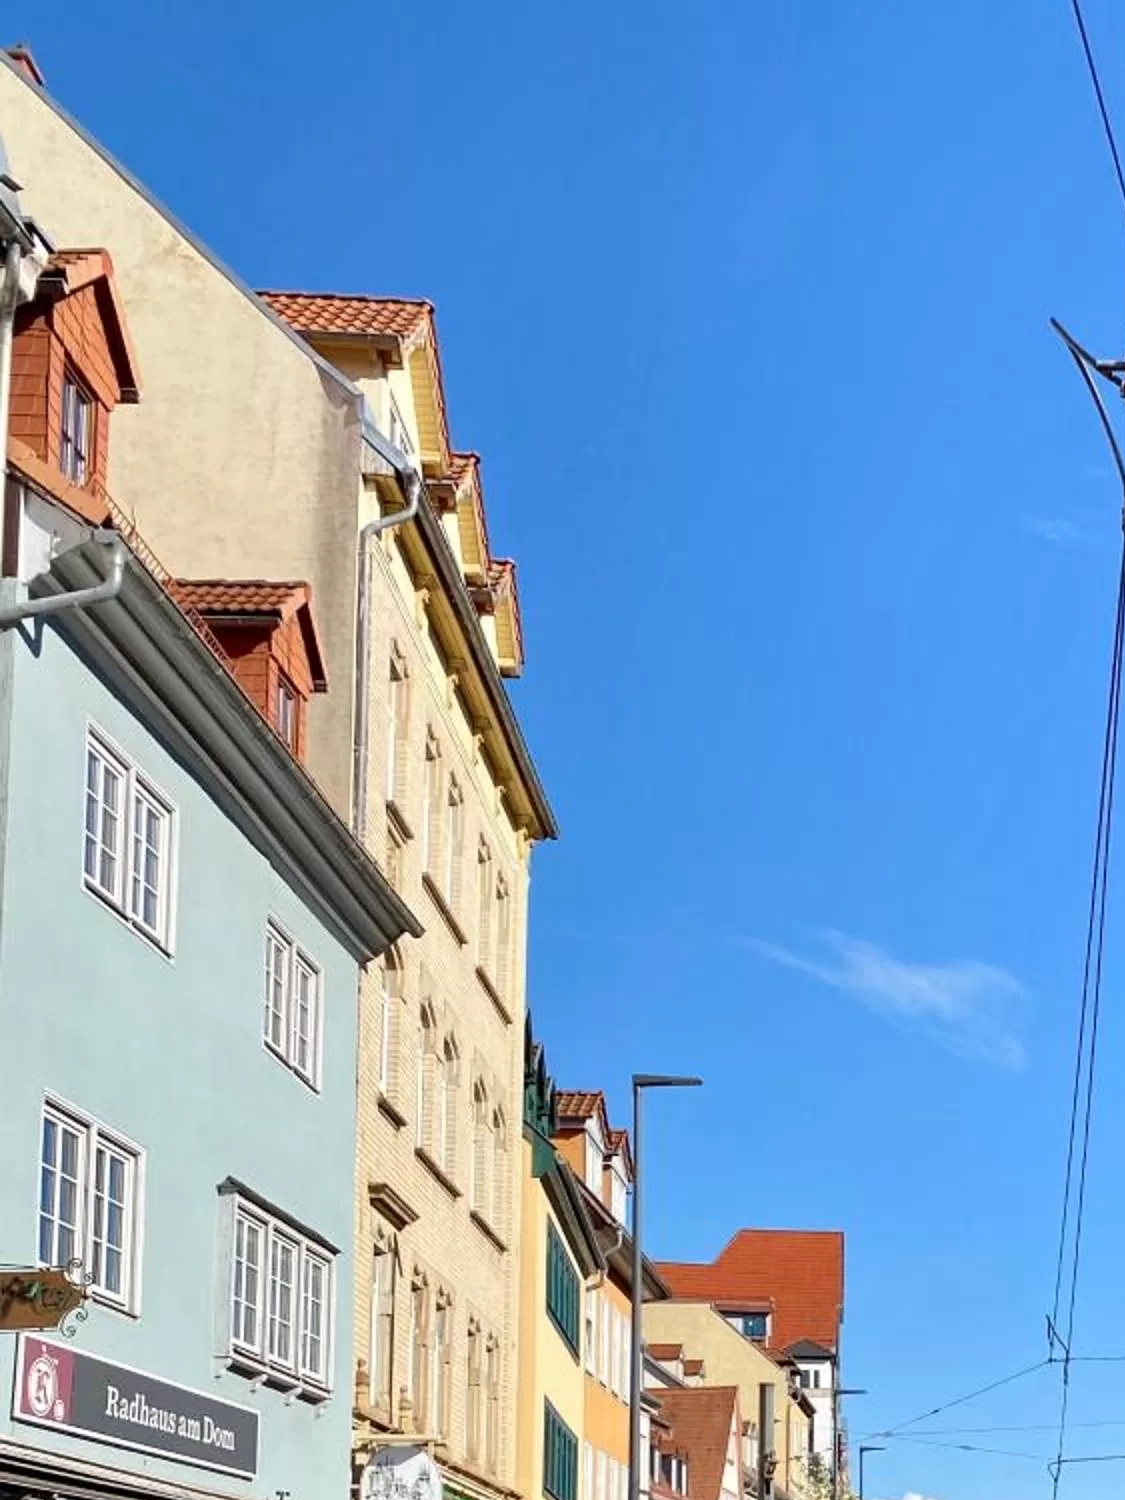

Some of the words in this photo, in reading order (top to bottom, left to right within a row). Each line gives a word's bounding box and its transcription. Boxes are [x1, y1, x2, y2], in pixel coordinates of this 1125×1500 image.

[105, 1385, 176, 1434] Radhaus
[178, 1415, 201, 1442] am
[203, 1416, 235, 1451] Dom
